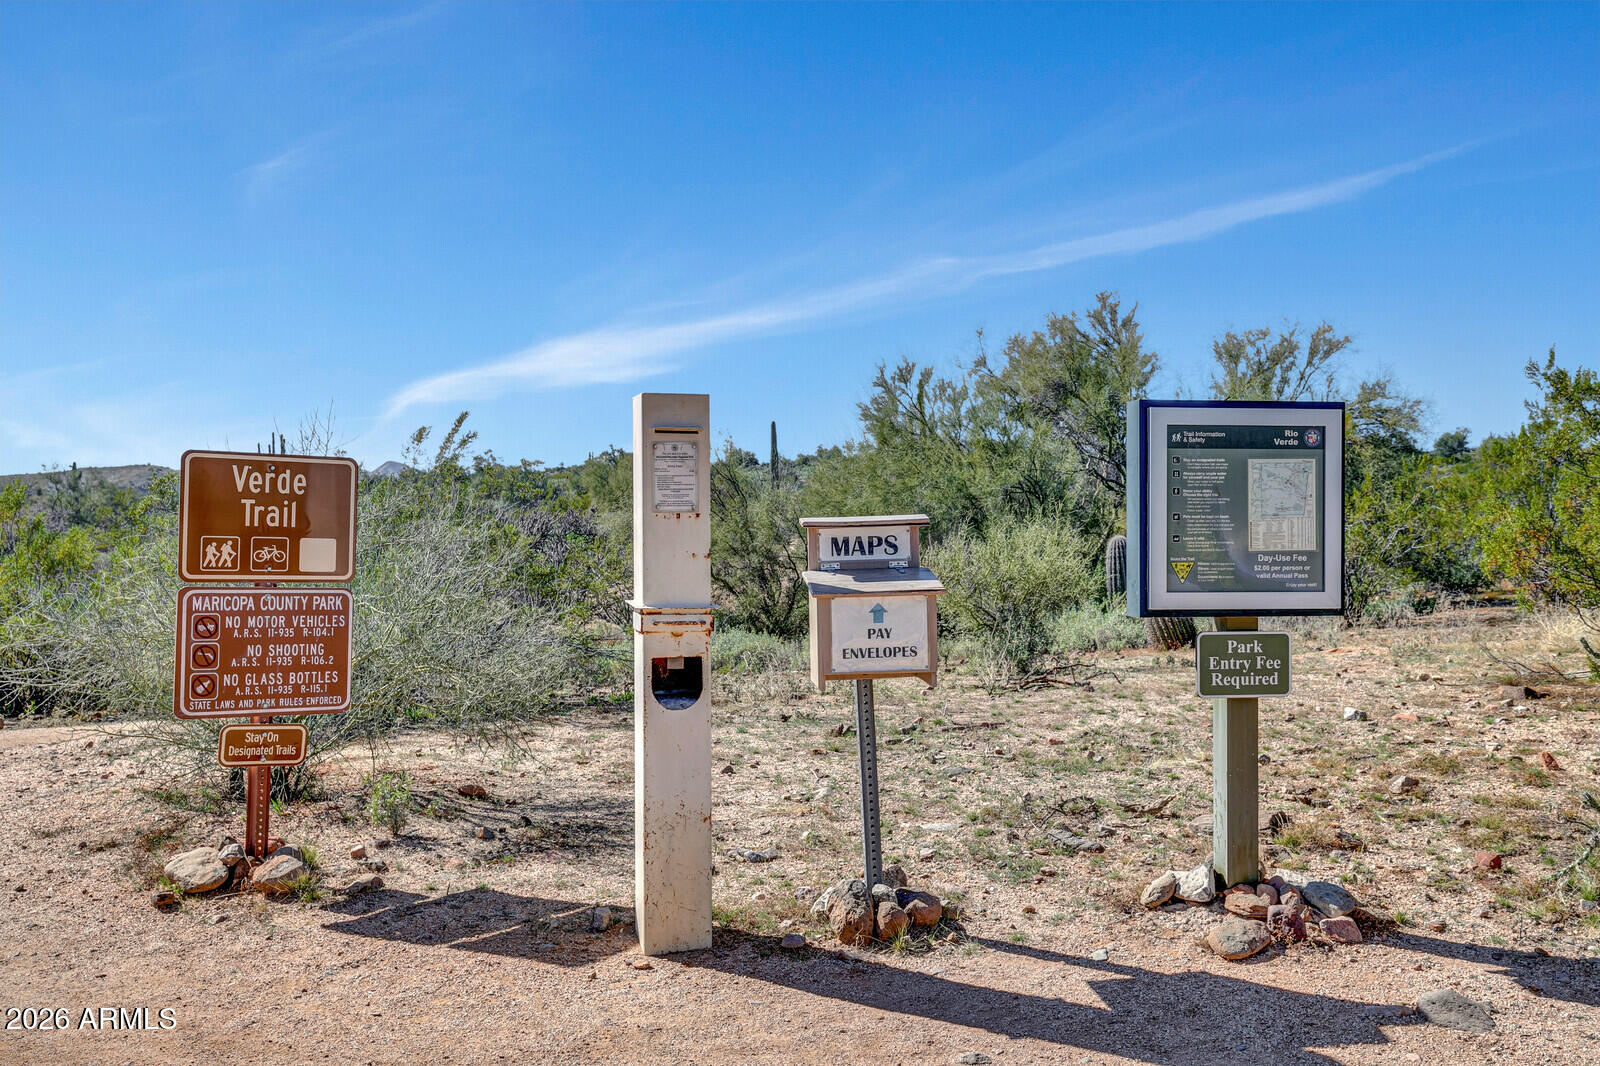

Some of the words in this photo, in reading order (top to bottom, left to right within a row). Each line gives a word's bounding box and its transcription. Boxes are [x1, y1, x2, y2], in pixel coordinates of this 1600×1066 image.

[232, 464, 307, 495] Verde
[240, 499, 296, 528] Trail
[830, 534, 899, 557] MAPS
[1258, 554, 1290, 563] Day-Use
[192, 596, 254, 611] MARICOPA
[260, 595, 308, 611] COUNTY
[313, 596, 342, 610] PARK
[225, 616, 240, 628] NO
[248, 616, 285, 628] MOTOR
[292, 615, 345, 627] VEHICLES
[233, 628, 262, 638] A.R.S.
[268, 628, 294, 637] 11-935
[303, 628, 334, 637] R-104.1
[867, 628, 892, 639] PAY
[247, 645, 262, 657] NO
[269, 644, 324, 656] SHOOTING
[842, 646, 918, 660] ENVELOPES
[1227, 640, 1263, 653] Park
[231, 658, 260, 667] A.R.S.
[266, 657, 292, 666] 11-935
[301, 656, 334, 665] R-106.2
[1209, 656, 1251, 672] Entry
[1256, 656, 1281, 669] Fee
[223, 674, 238, 686] NO
[245, 673, 283, 686] GLASS
[290, 671, 338, 684] BOTTLES
[1211, 672, 1278, 690] Required
[235, 687, 262, 696] A.R.S.
[268, 685, 292, 695] 11-935
[301, 684, 327, 694] R-115.1
[190, 701, 210, 710] STATE
[215, 700, 234, 709] LAWS
[239, 699, 253, 708] AND
[280, 697, 303, 706] RULES
[307, 696, 342, 705] ENFORCED
[245, 732, 264, 743] Stay
[267, 732, 278, 742] On
[228, 746, 273, 758] Designated
[276, 745, 296, 755] Trails
